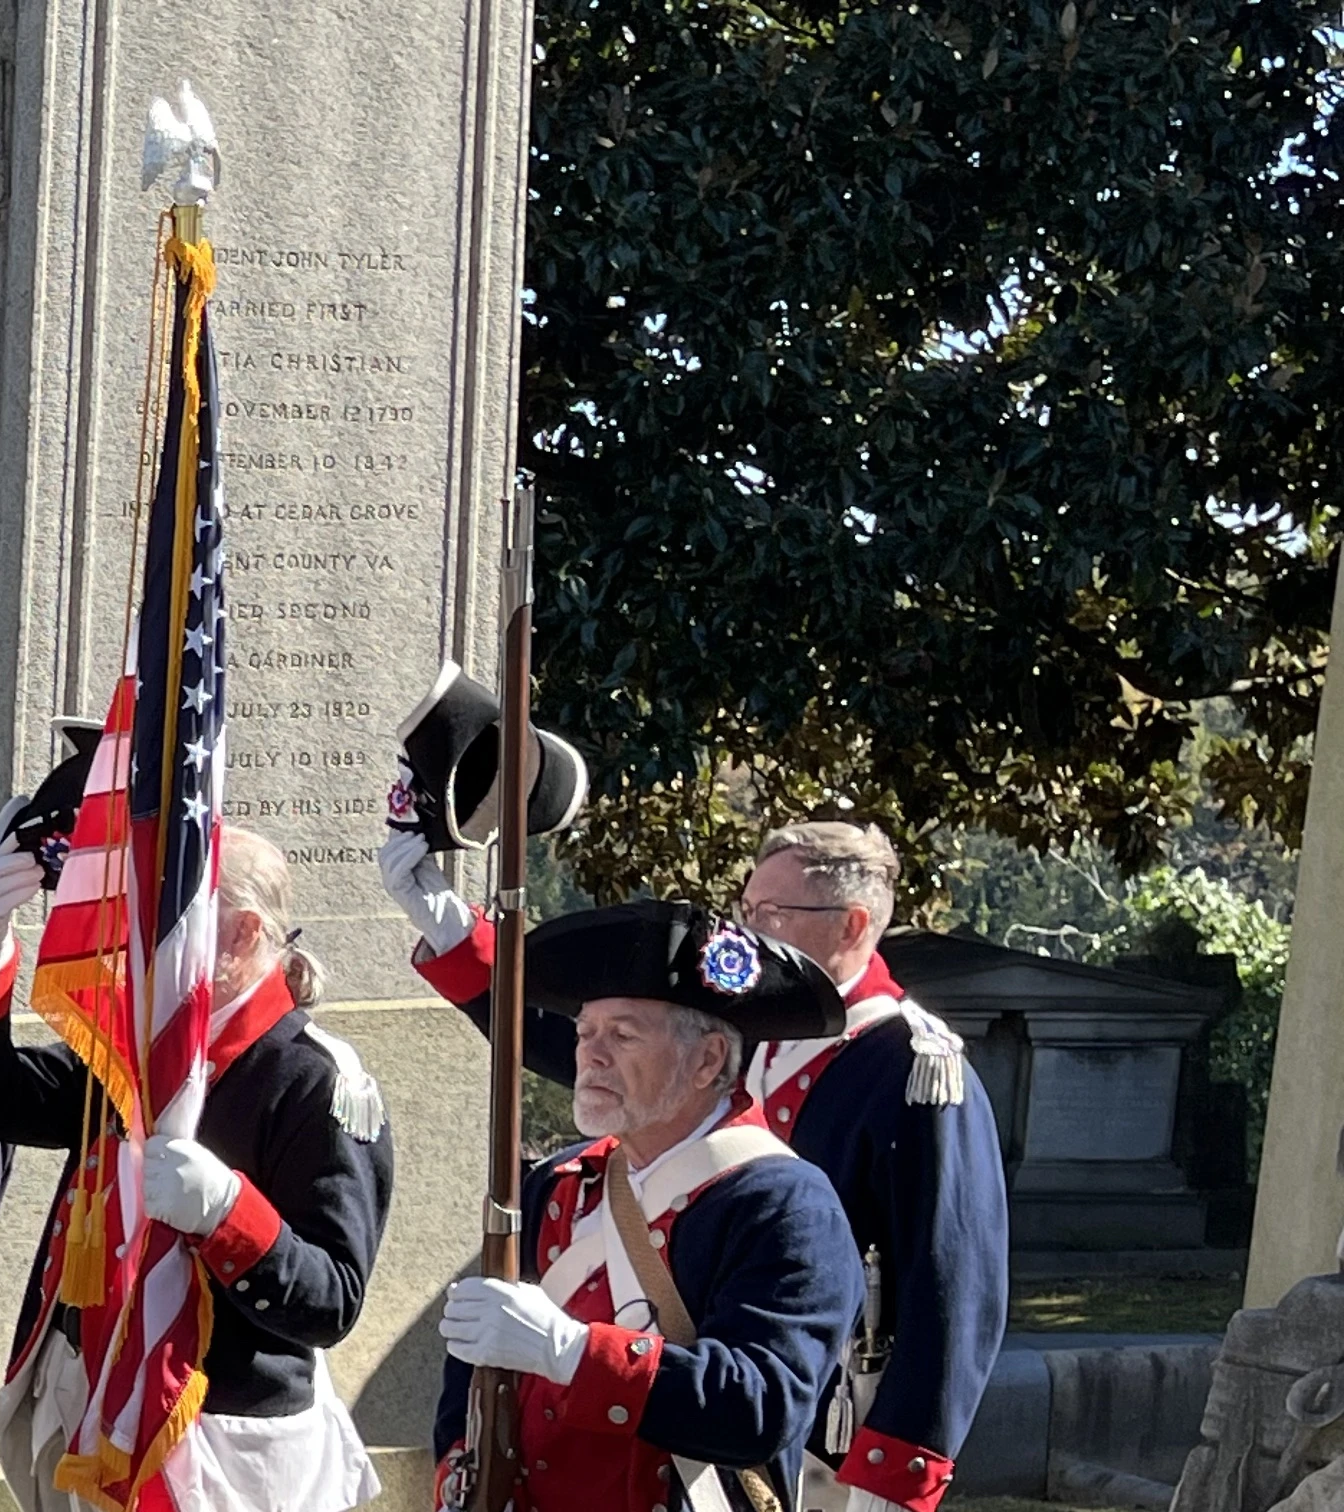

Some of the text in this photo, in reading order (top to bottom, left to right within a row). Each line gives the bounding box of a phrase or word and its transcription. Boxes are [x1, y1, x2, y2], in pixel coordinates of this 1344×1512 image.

[271, 250, 328, 269] JOHN
[338, 251, 407, 271] TYLER
[208, 299, 367, 322] ARRIED FIRST
[270, 352, 405, 374] CHRISTIAN
[224, 402, 331, 422] OVEMBER
[224, 452, 303, 471] TEMBER
[313, 455, 336, 471] 10
[241, 504, 266, 520] AT
[274, 504, 341, 520] CEDAR
[349, 504, 419, 521] GROVE
[222, 552, 394, 571] ENT COUNTY VA
[278, 602, 371, 620] SECOND
[249, 652, 355, 670] GARDINER
[227, 702, 281, 719] JULY
[289, 701, 312, 719] 23
[224, 752, 281, 768] JULY
[290, 751, 311, 767] 10
[258, 799, 287, 816] BY
[291, 799, 322, 816] HIS
[332, 798, 379, 815] SIDE
[286, 847, 375, 865] ONUMEN
